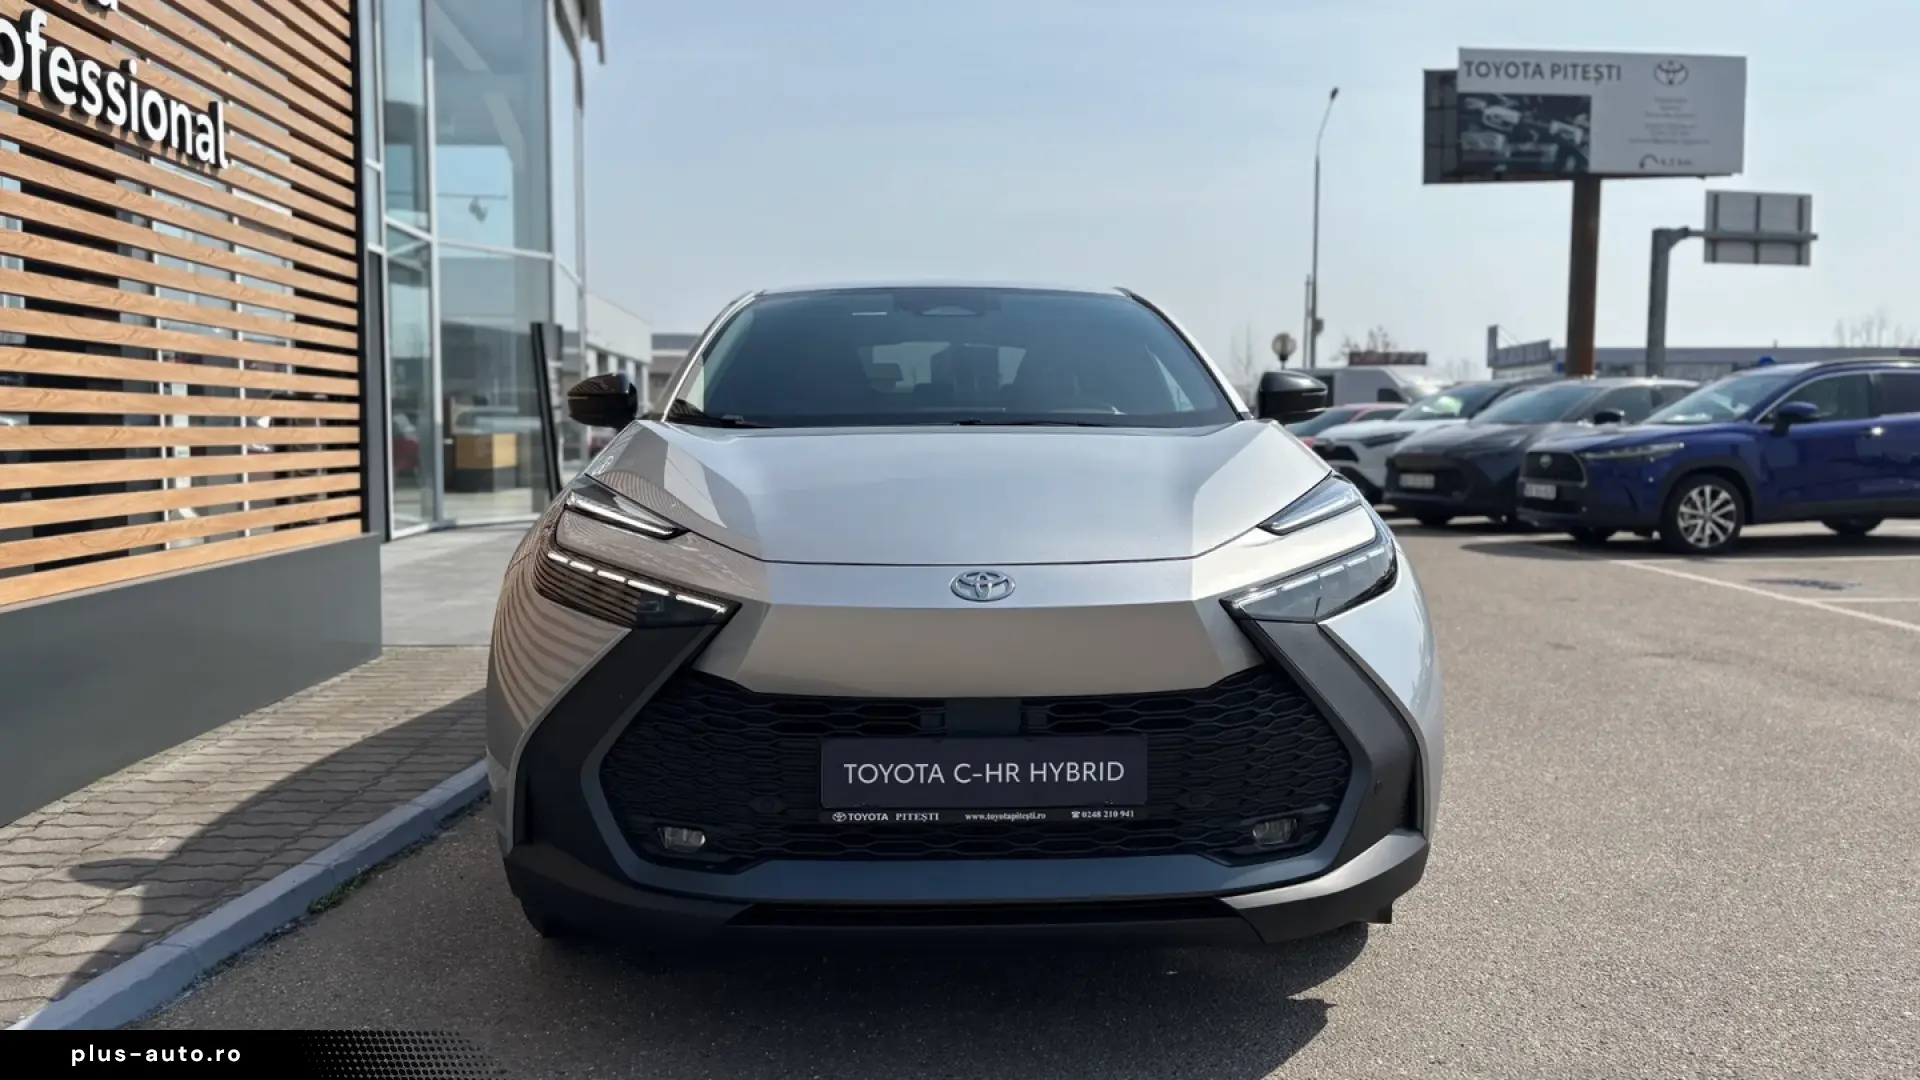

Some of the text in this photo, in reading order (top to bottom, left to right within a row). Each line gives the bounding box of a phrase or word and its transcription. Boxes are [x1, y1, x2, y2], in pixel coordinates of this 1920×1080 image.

[1463, 60, 1545, 80] TOYOTA
[0, 8, 229, 169] ofessional
[843, 761, 1125, 784] TOYOTA C-HR HYBRID
[847, 812, 889, 821] TOYOTA
[1104, 810, 1118, 818] 210
[1120, 810, 1134, 818] 941
